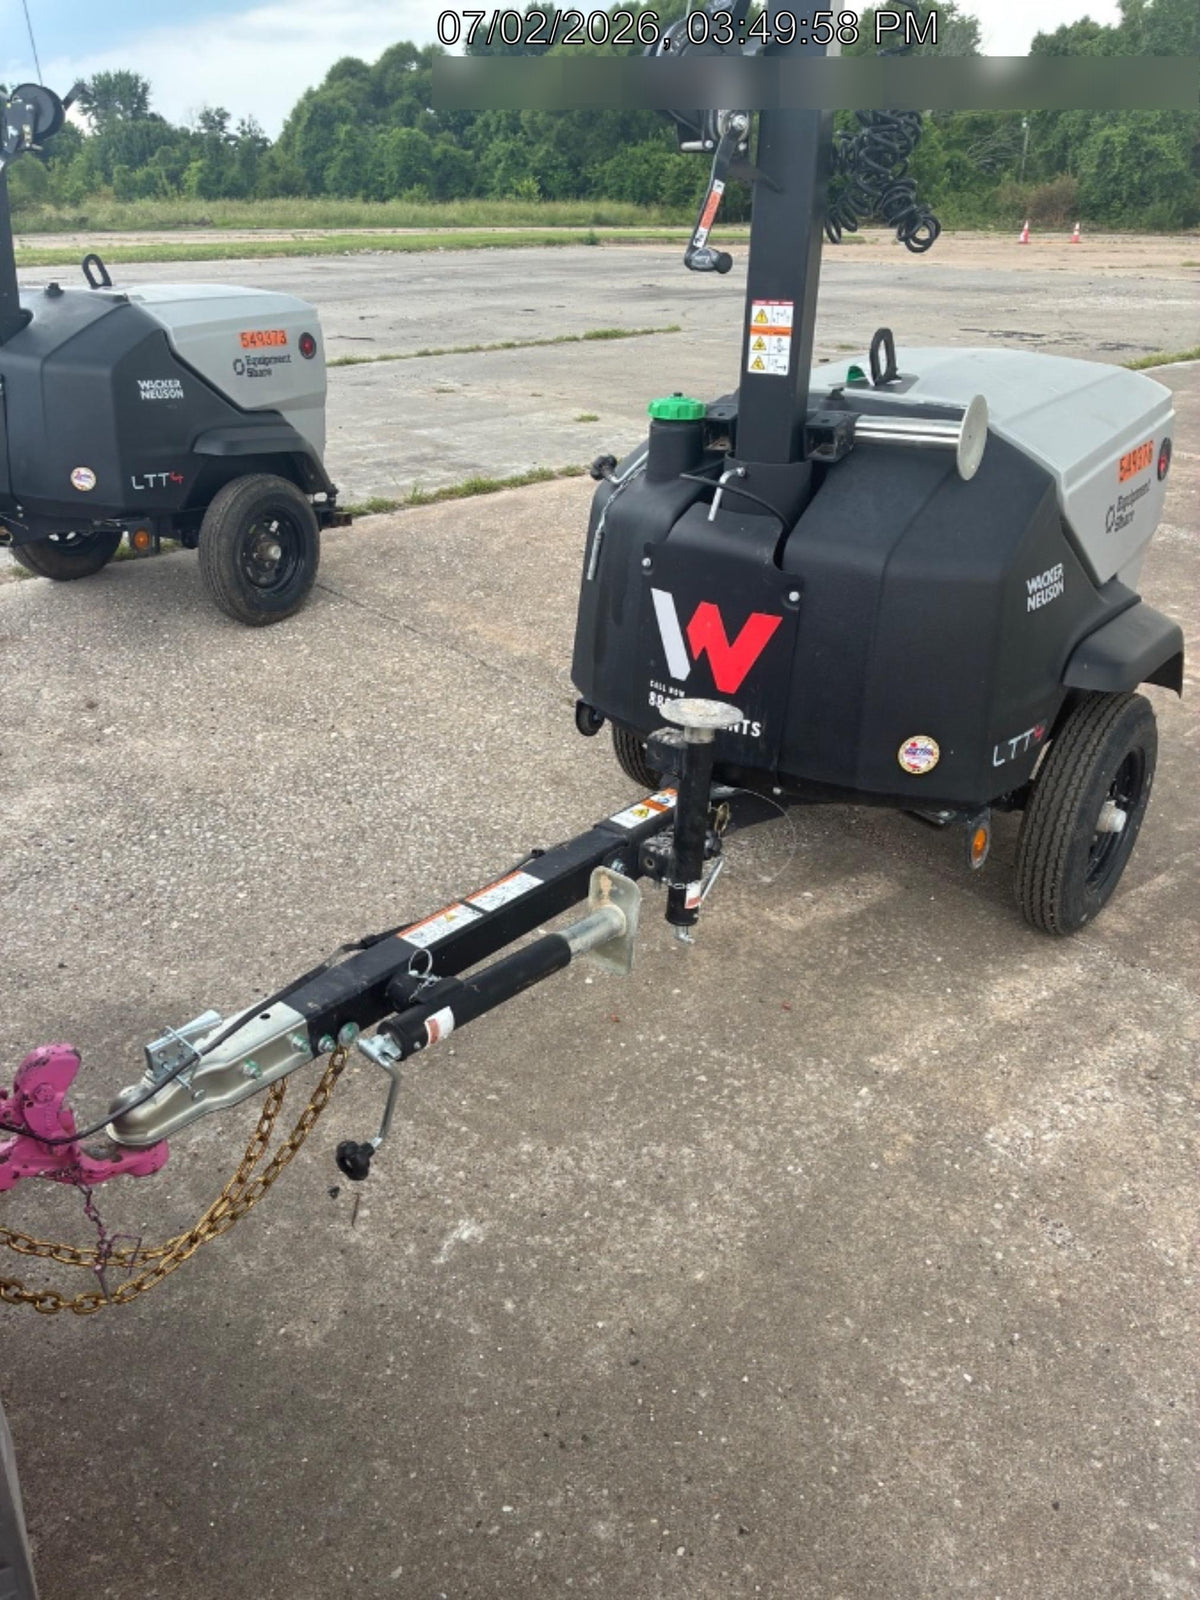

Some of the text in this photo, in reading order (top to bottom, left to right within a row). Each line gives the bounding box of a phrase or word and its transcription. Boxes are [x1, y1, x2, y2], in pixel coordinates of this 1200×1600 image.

[245, 354, 292, 368] Equipment
[138, 379, 181, 390] WACKER
[140, 389, 184, 400] NEUSON
[131, 472, 184, 489] LTT4
[1026, 563, 1064, 594] WACKER
[1027, 578, 1064, 612] NEUSON
[993, 725, 1044, 767] LTT4
